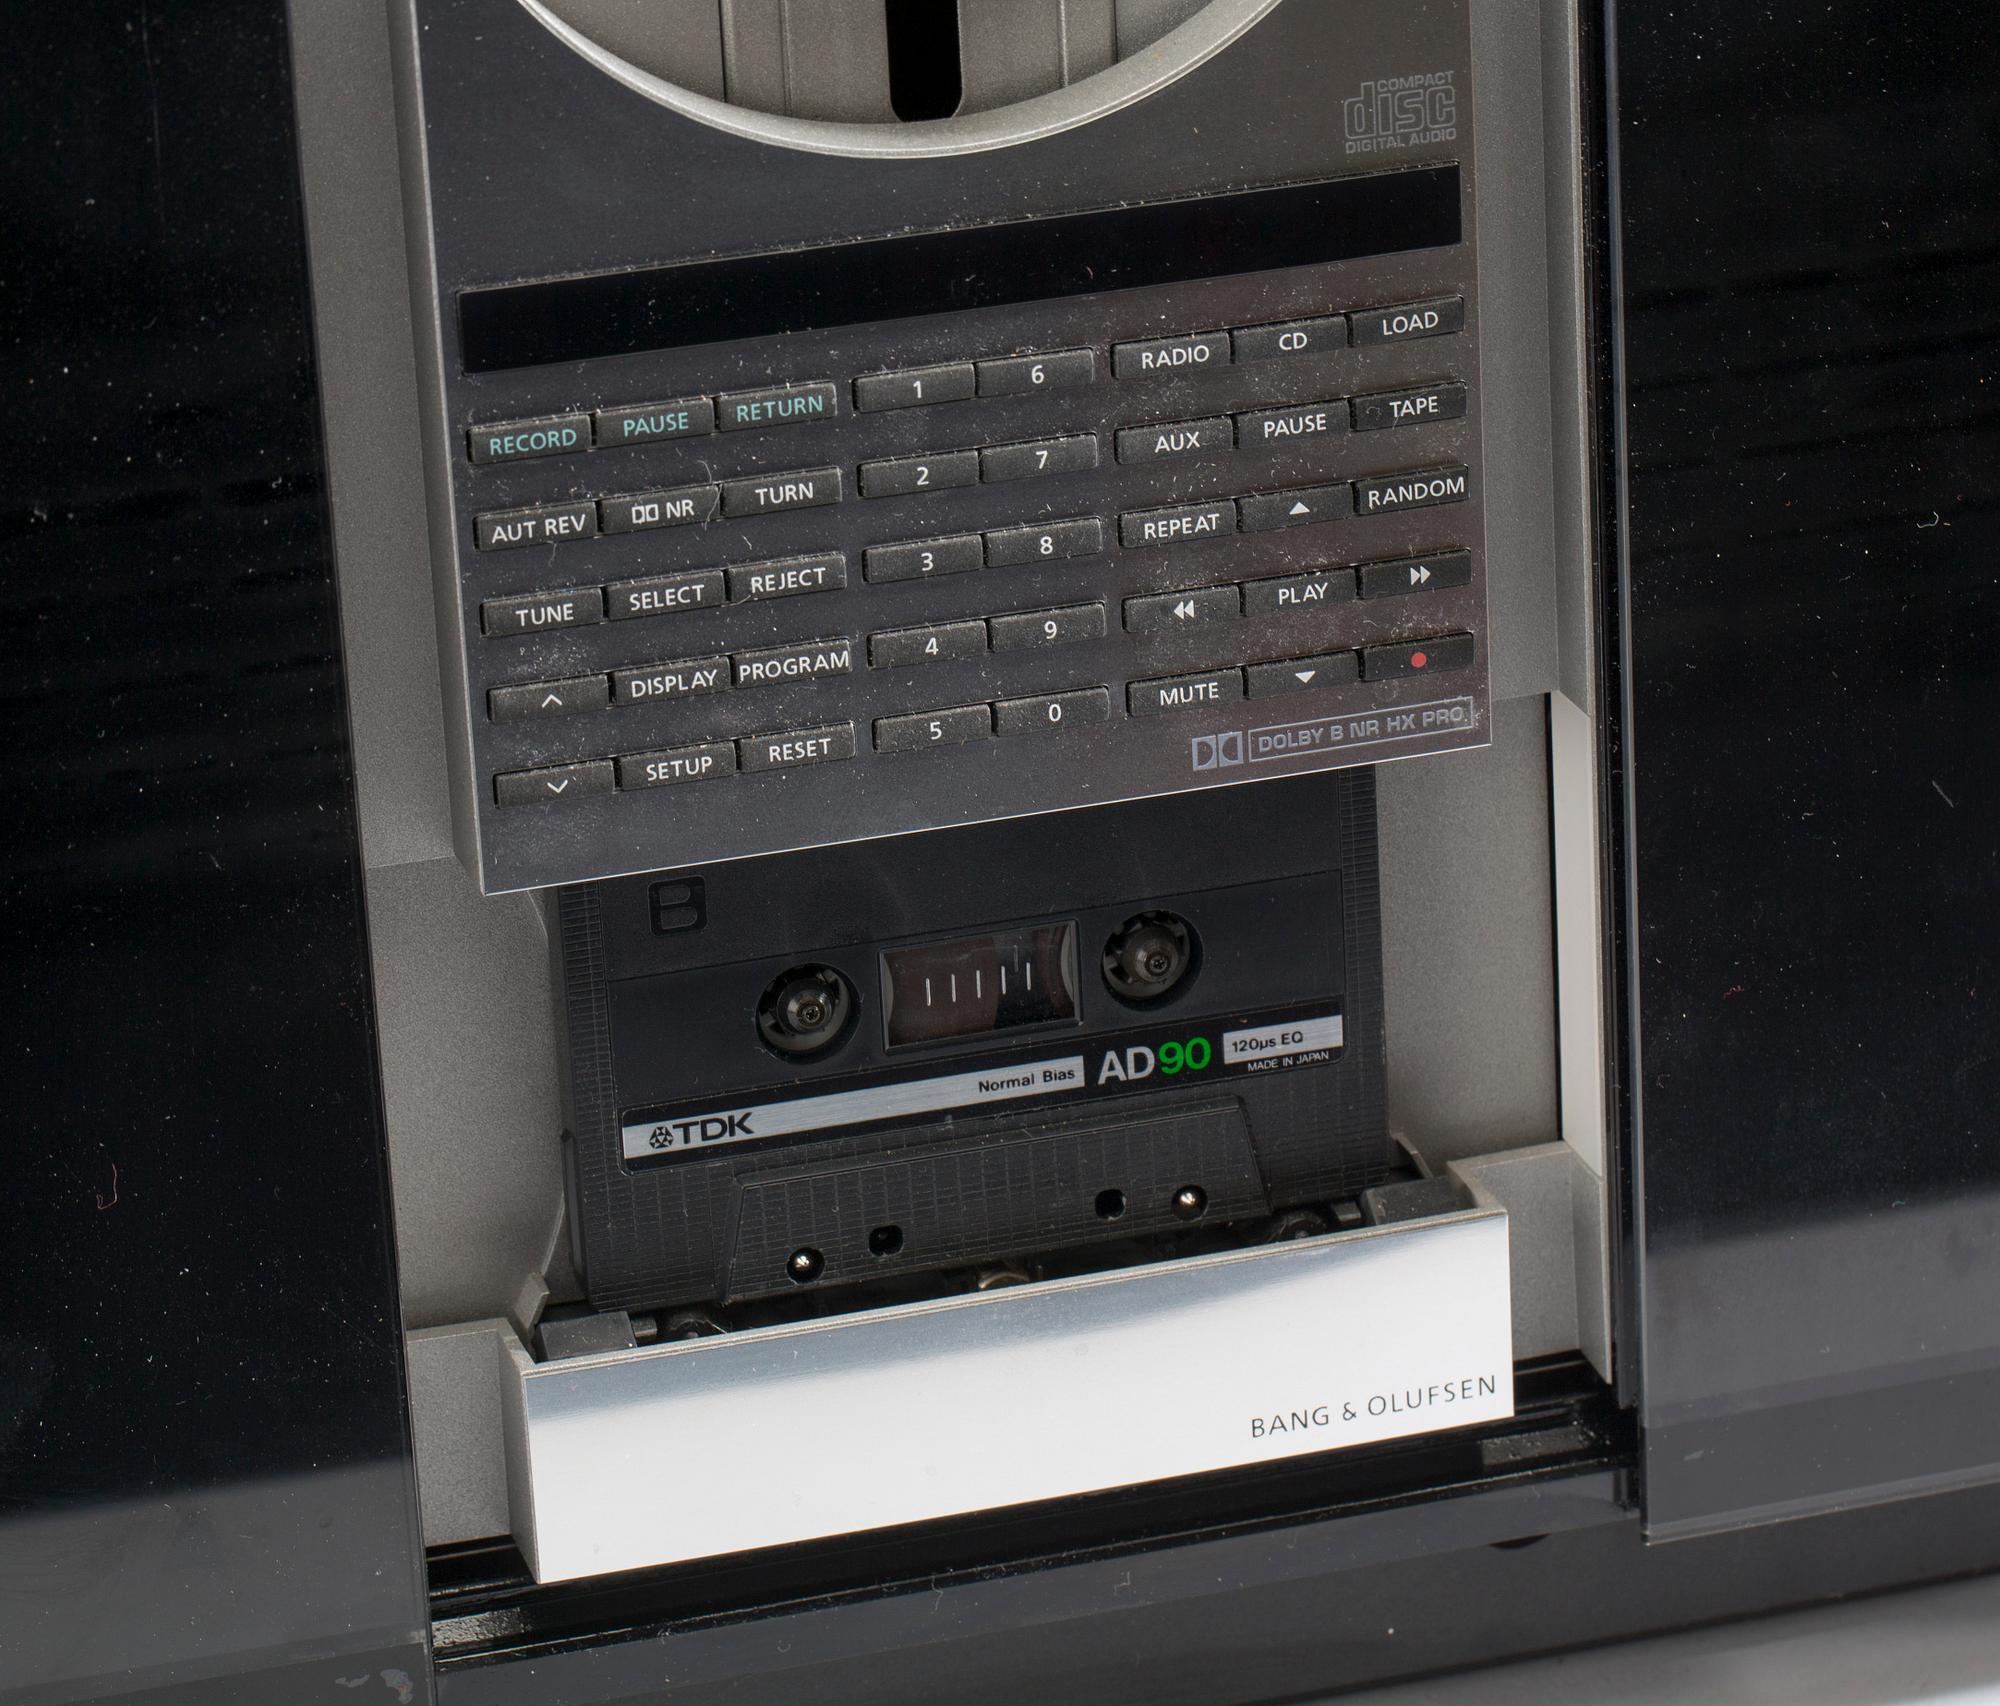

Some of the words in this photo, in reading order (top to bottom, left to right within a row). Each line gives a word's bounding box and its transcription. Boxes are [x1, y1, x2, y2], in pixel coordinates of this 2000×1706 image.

[1377, 70, 1454, 92] COMPACT
[1345, 136, 1406, 154] DIGITAL
[1408, 128, 1457, 147] AUDIO
[1382, 311, 1439, 336] LOAD
[1278, 332, 1308, 351] CD
[1141, 345, 1210, 370] RADIO
[1031, 364, 1045, 384] 6
[912, 380, 922, 399] 1
[736, 395, 824, 423] RETURN
[1389, 396, 1439, 418] TAPE
[623, 412, 689, 438] PAUSE
[1263, 413, 1327, 438] PAUSE
[489, 428, 577, 456] RECORD
[1154, 431, 1201, 453] AUX
[1035, 450, 1048, 469] 7
[916, 467, 930, 486] 2
[754, 482, 814, 505] TURN
[1368, 476, 1465, 509] RANDOM
[666, 500, 695, 519] NR
[491, 521, 537, 544] AUT
[544, 514, 587, 535] REV
[1144, 513, 1220, 539] REPEAT
[1039, 536, 1053, 555] 8
[920, 552, 934, 571] 3
[750, 567, 826, 594] REJECT
[629, 584, 705, 612] SELECT
[1278, 582, 1329, 605] PLAY
[515, 603, 574, 627] TUNE
[1044, 620, 1057, 639] 9
[925, 637, 939, 656] 4
[738, 650, 849, 682] PROGRAM
[631, 669, 718, 698] DISPLAY
[1159, 682, 1219, 706] MUTE
[1048, 703, 1062, 722] 0
[929, 721, 942, 740] 5
[1258, 728, 1324, 753] DOLBY
[1330, 724, 1344, 741] B
[1350, 718, 1379, 738] NR
[1387, 712, 1415, 732] HX
[1422, 706, 1464, 727] PRO
[768, 738, 832, 762] RESET
[645, 756, 713, 781] SETUP
[648, 875, 708, 936] B
[1280, 1030, 1304, 1046] EQ
[1247, 1058, 1280, 1072] MADE
[1282, 1056, 1293, 1067] IN
[1296, 1050, 1330, 1065] JAPAN
[978, 1073, 1036, 1093] Normal
[1043, 1068, 1076, 1084] Bias
[672, 1112, 755, 1145] TDK
[1251, 1406, 1330, 1438] BANG
[1342, 1402, 1357, 1421] &
[1367, 1375, 1496, 1416] OLUFSEN
